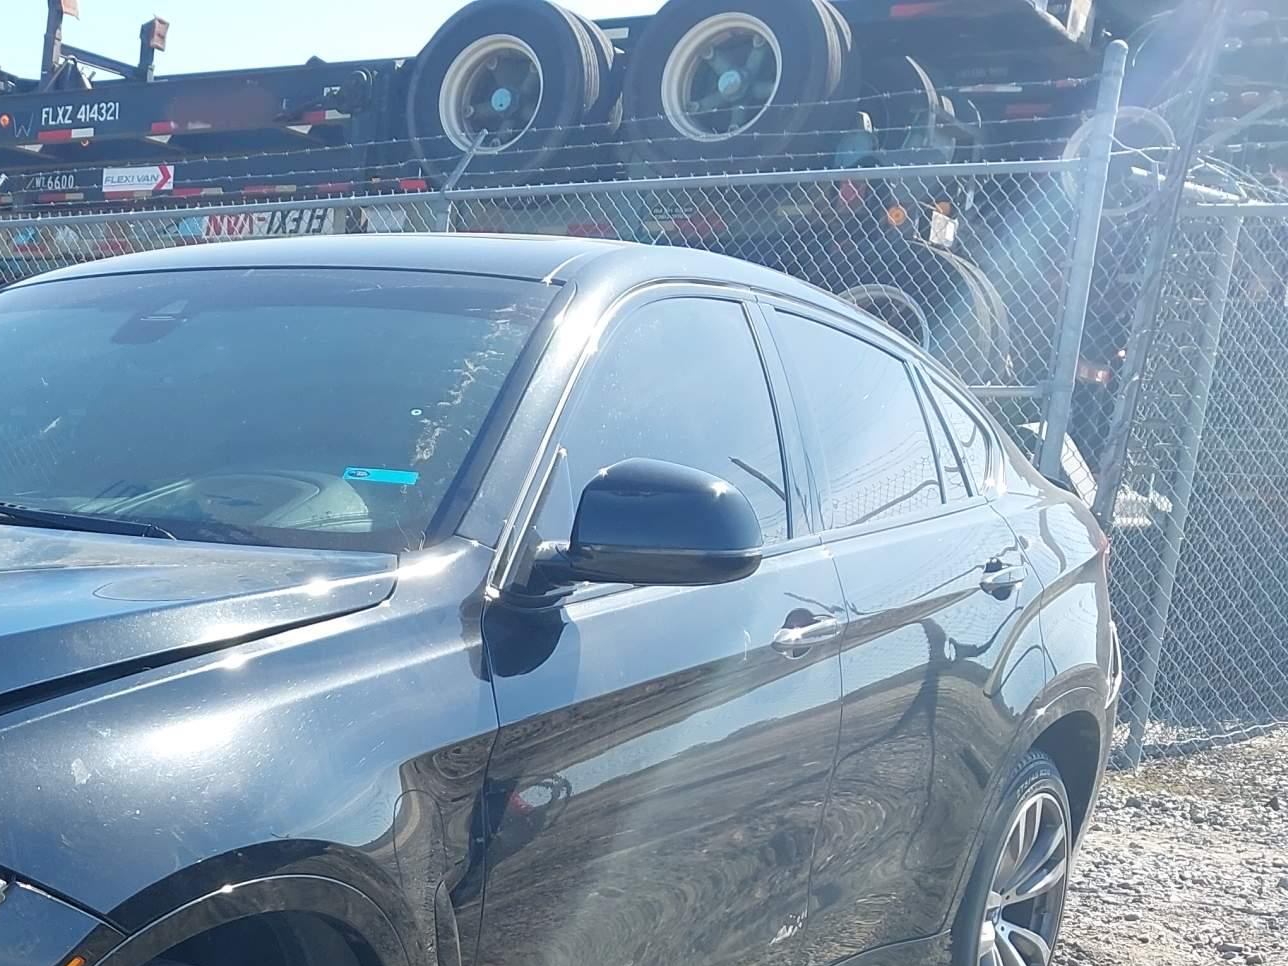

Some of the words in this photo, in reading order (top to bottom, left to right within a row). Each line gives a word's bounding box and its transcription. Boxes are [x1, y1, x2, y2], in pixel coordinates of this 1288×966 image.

[41, 105, 73, 126] FLXZ
[76, 102, 120, 123] 414321
[136, 174, 160, 182] VAN
